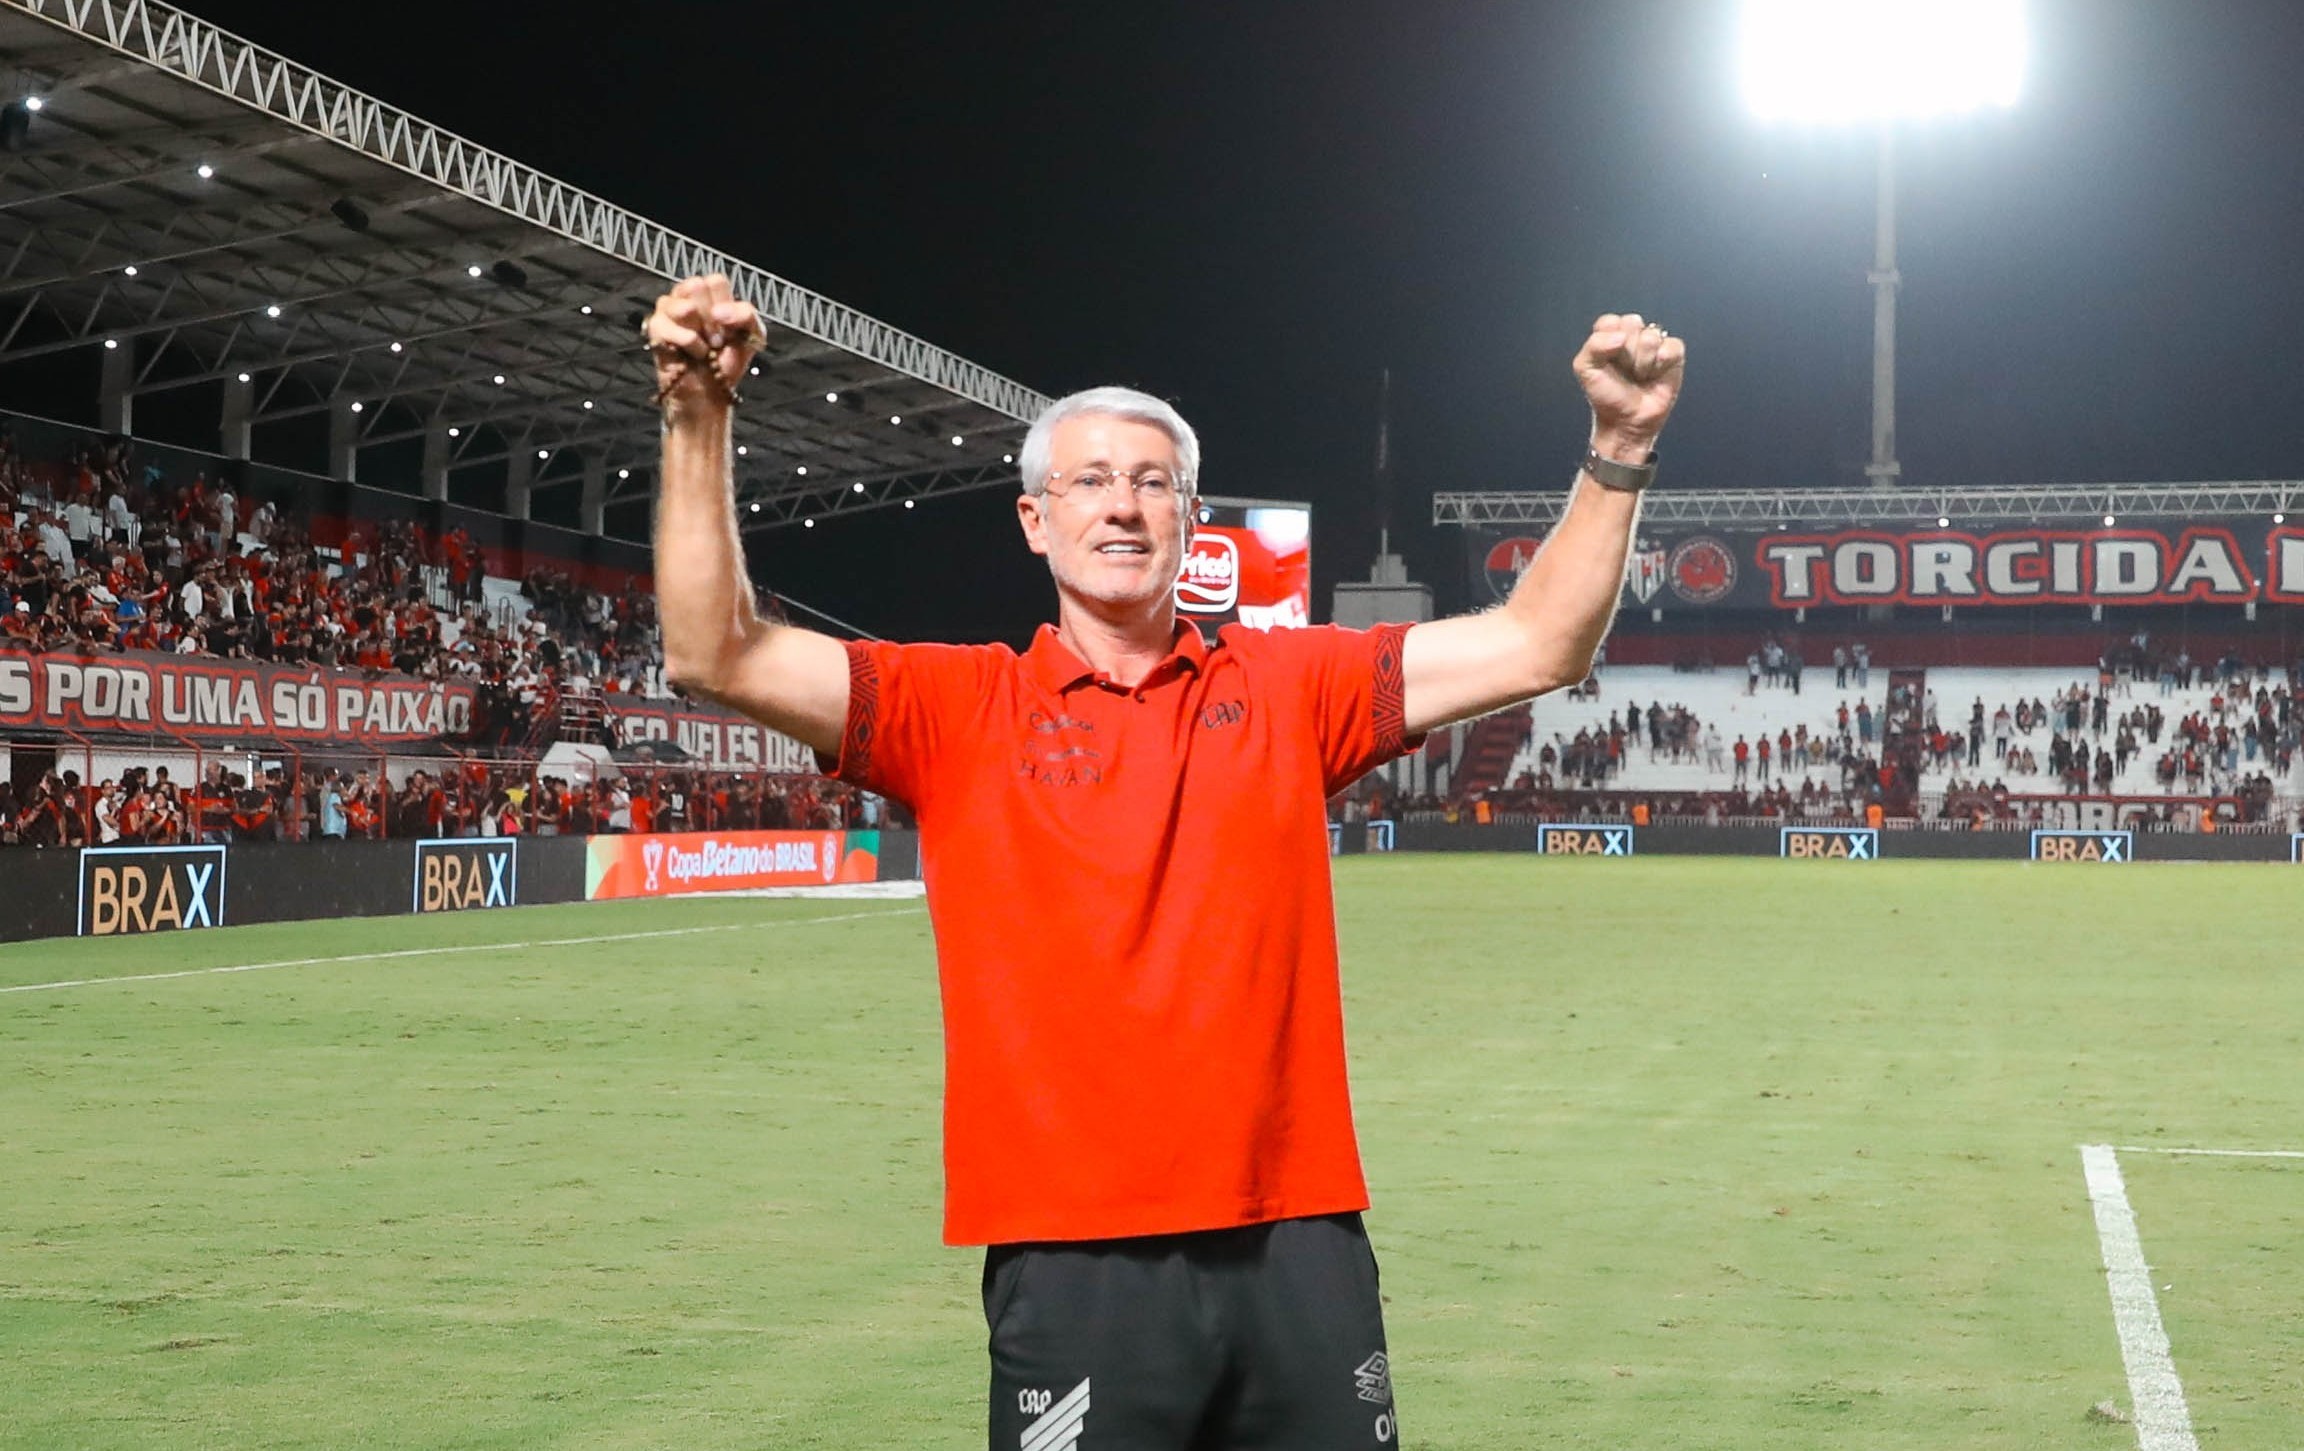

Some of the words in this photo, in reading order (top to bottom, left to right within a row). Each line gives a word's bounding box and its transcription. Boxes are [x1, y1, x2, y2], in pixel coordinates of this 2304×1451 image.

[1769, 540, 2247, 597] TORCIDA
[46, 663, 151, 721] POR
[162, 674, 265, 727] UMA
[272, 672, 328, 731] SÓ
[337, 683, 470, 734] PAIXÃO
[668, 845, 702, 884] Copa
[702, 840, 758, 878] Betano
[758, 844, 774, 872] do
[775, 842, 818, 872] BRASIL
[1546, 829, 1625, 857] BRAX
[1789, 833, 1868, 860] BRAX
[2041, 837, 2122, 862] BRAX
[93, 863, 213, 935] BRAX
[423, 853, 508, 912] BRAX
[1018, 1388, 1052, 1415] CAP
